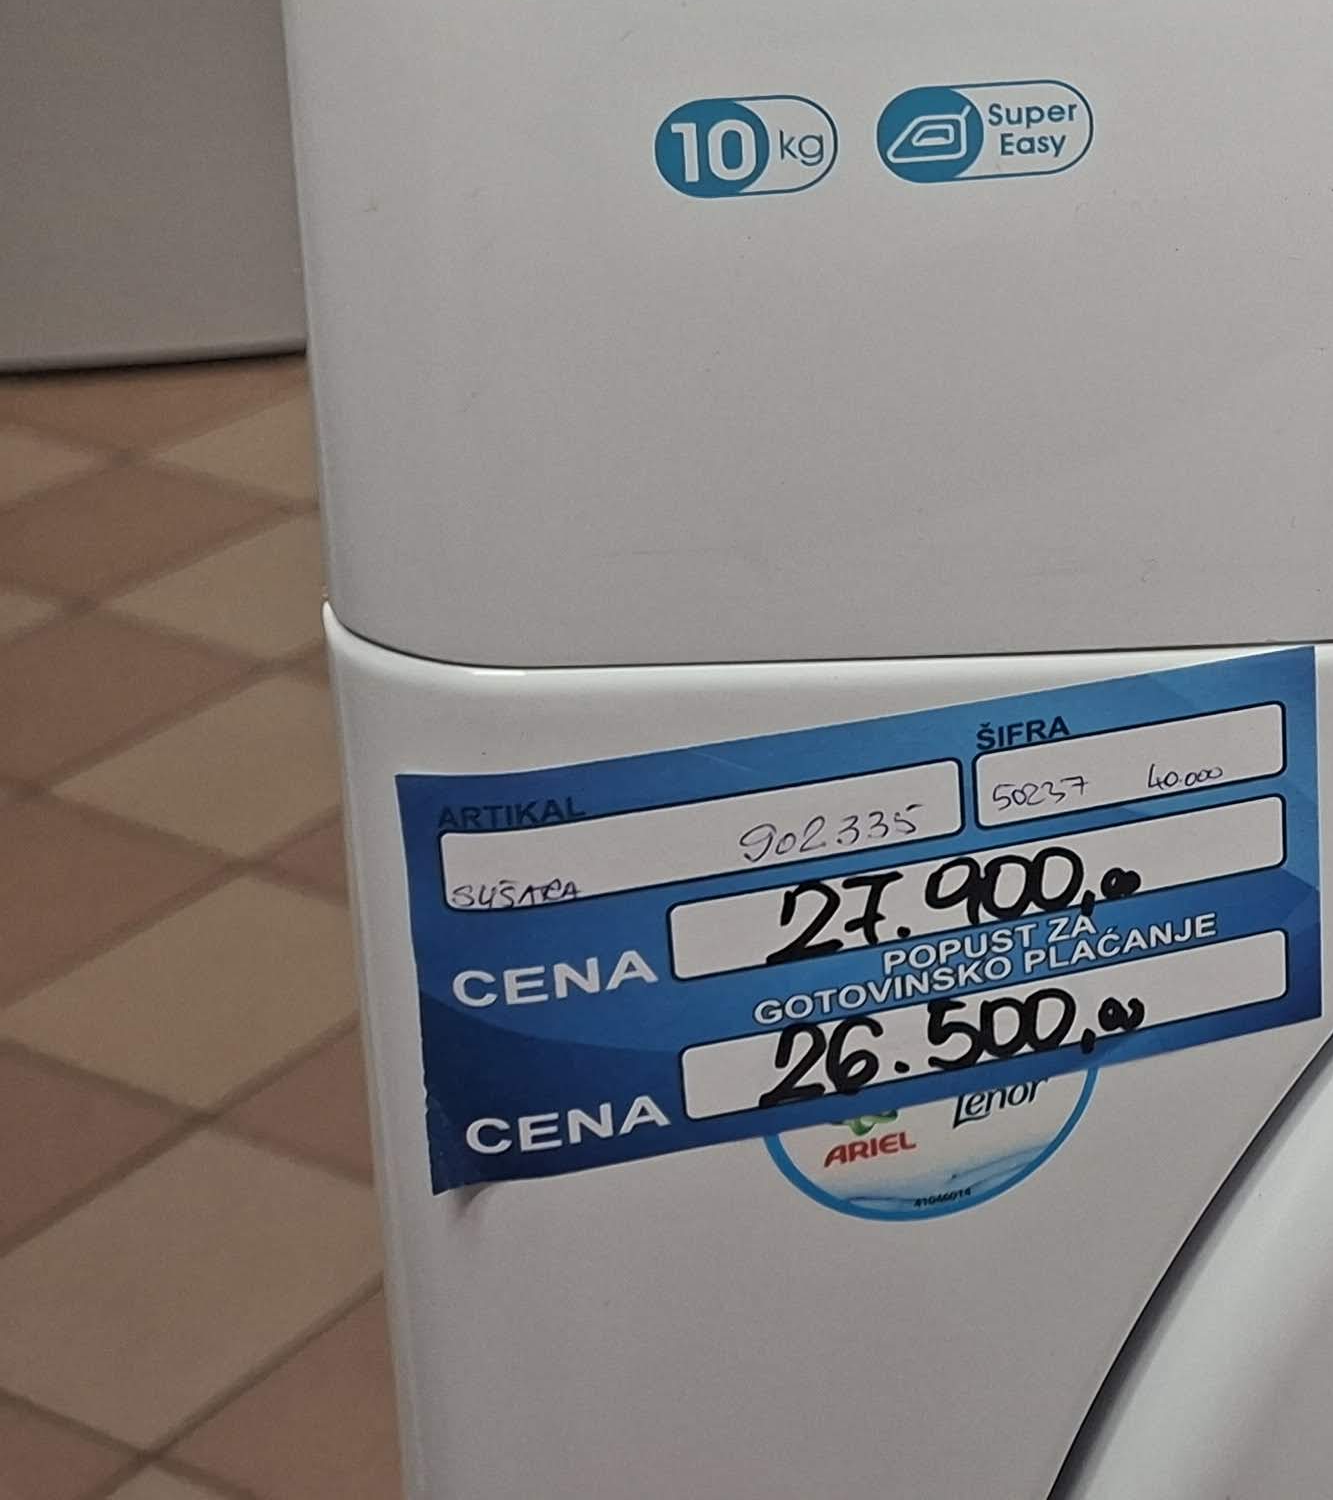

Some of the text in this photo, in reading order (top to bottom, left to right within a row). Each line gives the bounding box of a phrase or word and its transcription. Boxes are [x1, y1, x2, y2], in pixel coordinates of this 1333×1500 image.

[988, 102, 1078, 128] Super
[671, 119, 825, 183] 10 kg
[1000, 133, 1067, 159] Easy
[976, 716, 1070, 750] ŠIFRA
[438, 797, 586, 828] ARTIKAL
[992, 775, 1088, 811] 50237
[883, 914, 1098, 975] POPUST ZA
[453, 950, 659, 1007] CENA
[753, 912, 1218, 1022] GOTOVINSKO PLAĆANJE
[466, 1095, 671, 1154] CENA
[953, 1077, 1048, 1129] Lenor
[824, 1132, 917, 1168] ARIEL
